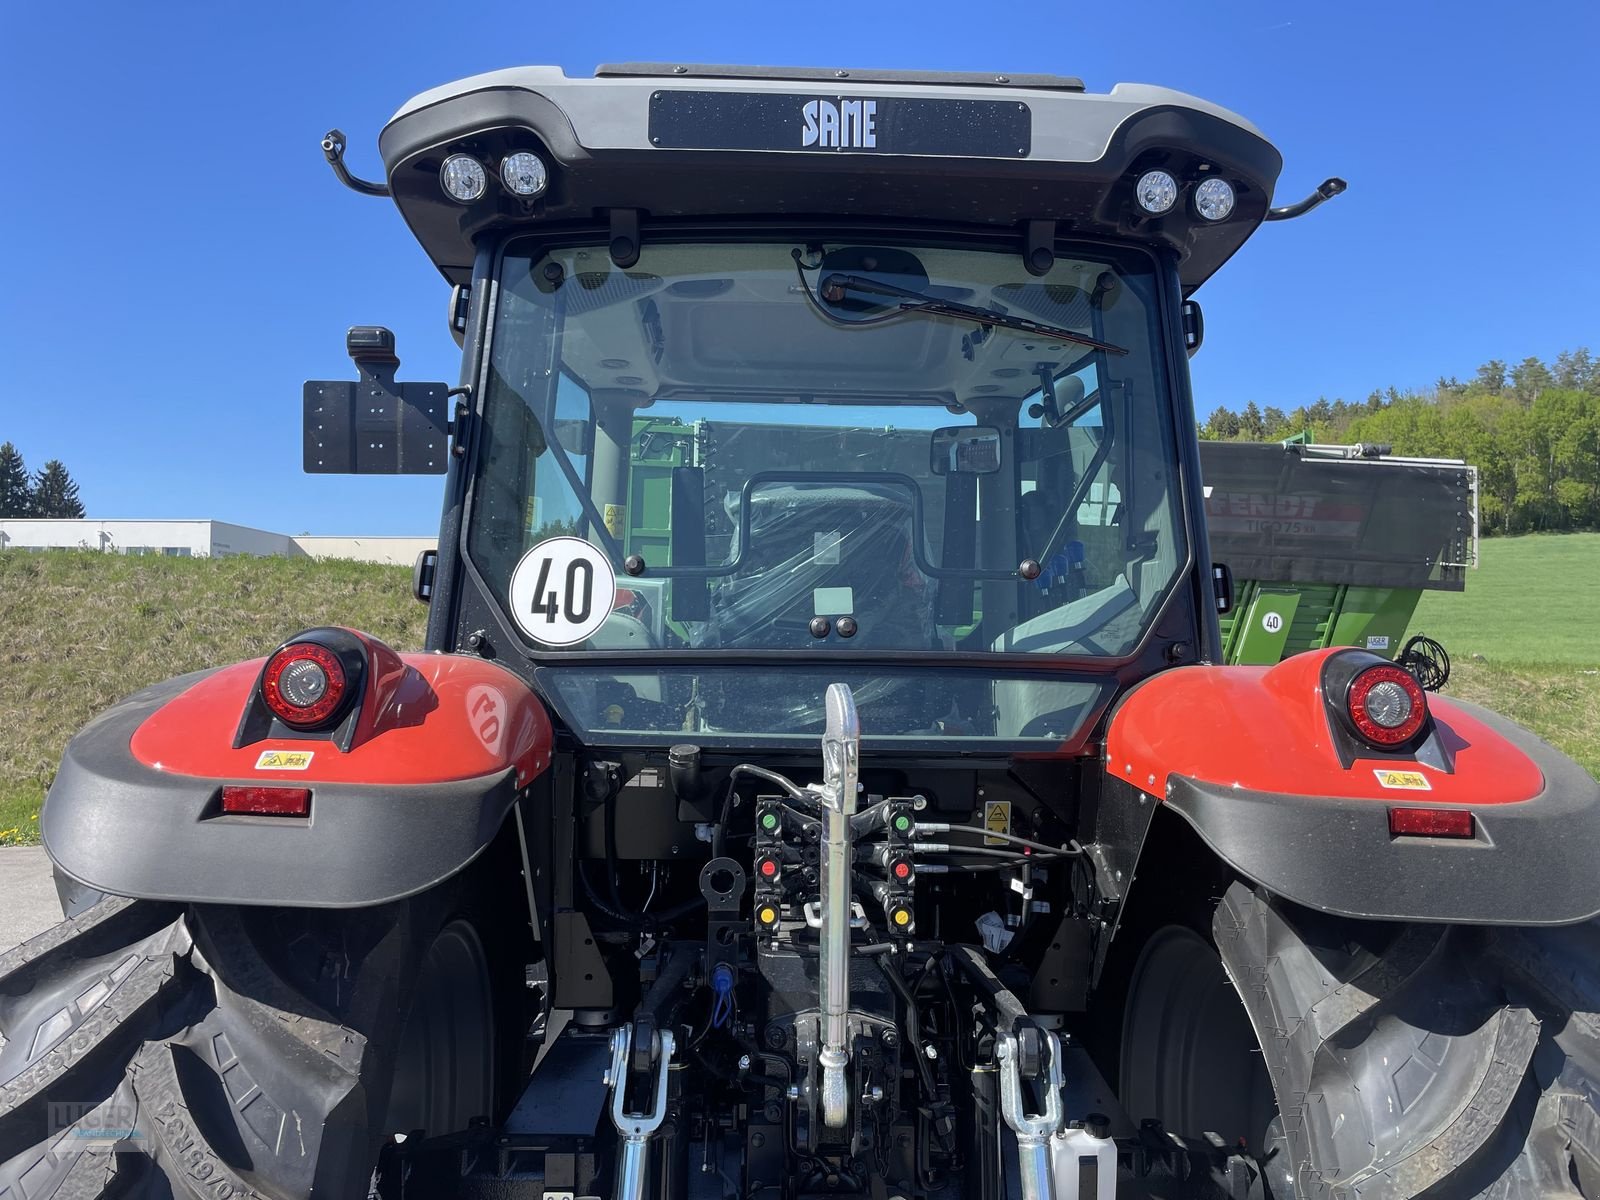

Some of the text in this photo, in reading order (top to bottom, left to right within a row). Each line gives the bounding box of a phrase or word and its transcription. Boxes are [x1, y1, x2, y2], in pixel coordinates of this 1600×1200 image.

[802, 99, 877, 148] SAME
[1211, 493, 1322, 517] FENDT
[531, 557, 594, 625] 40
[1266, 616, 1279, 630] 40
[4, 1008, 118, 1105] 540/65R3
